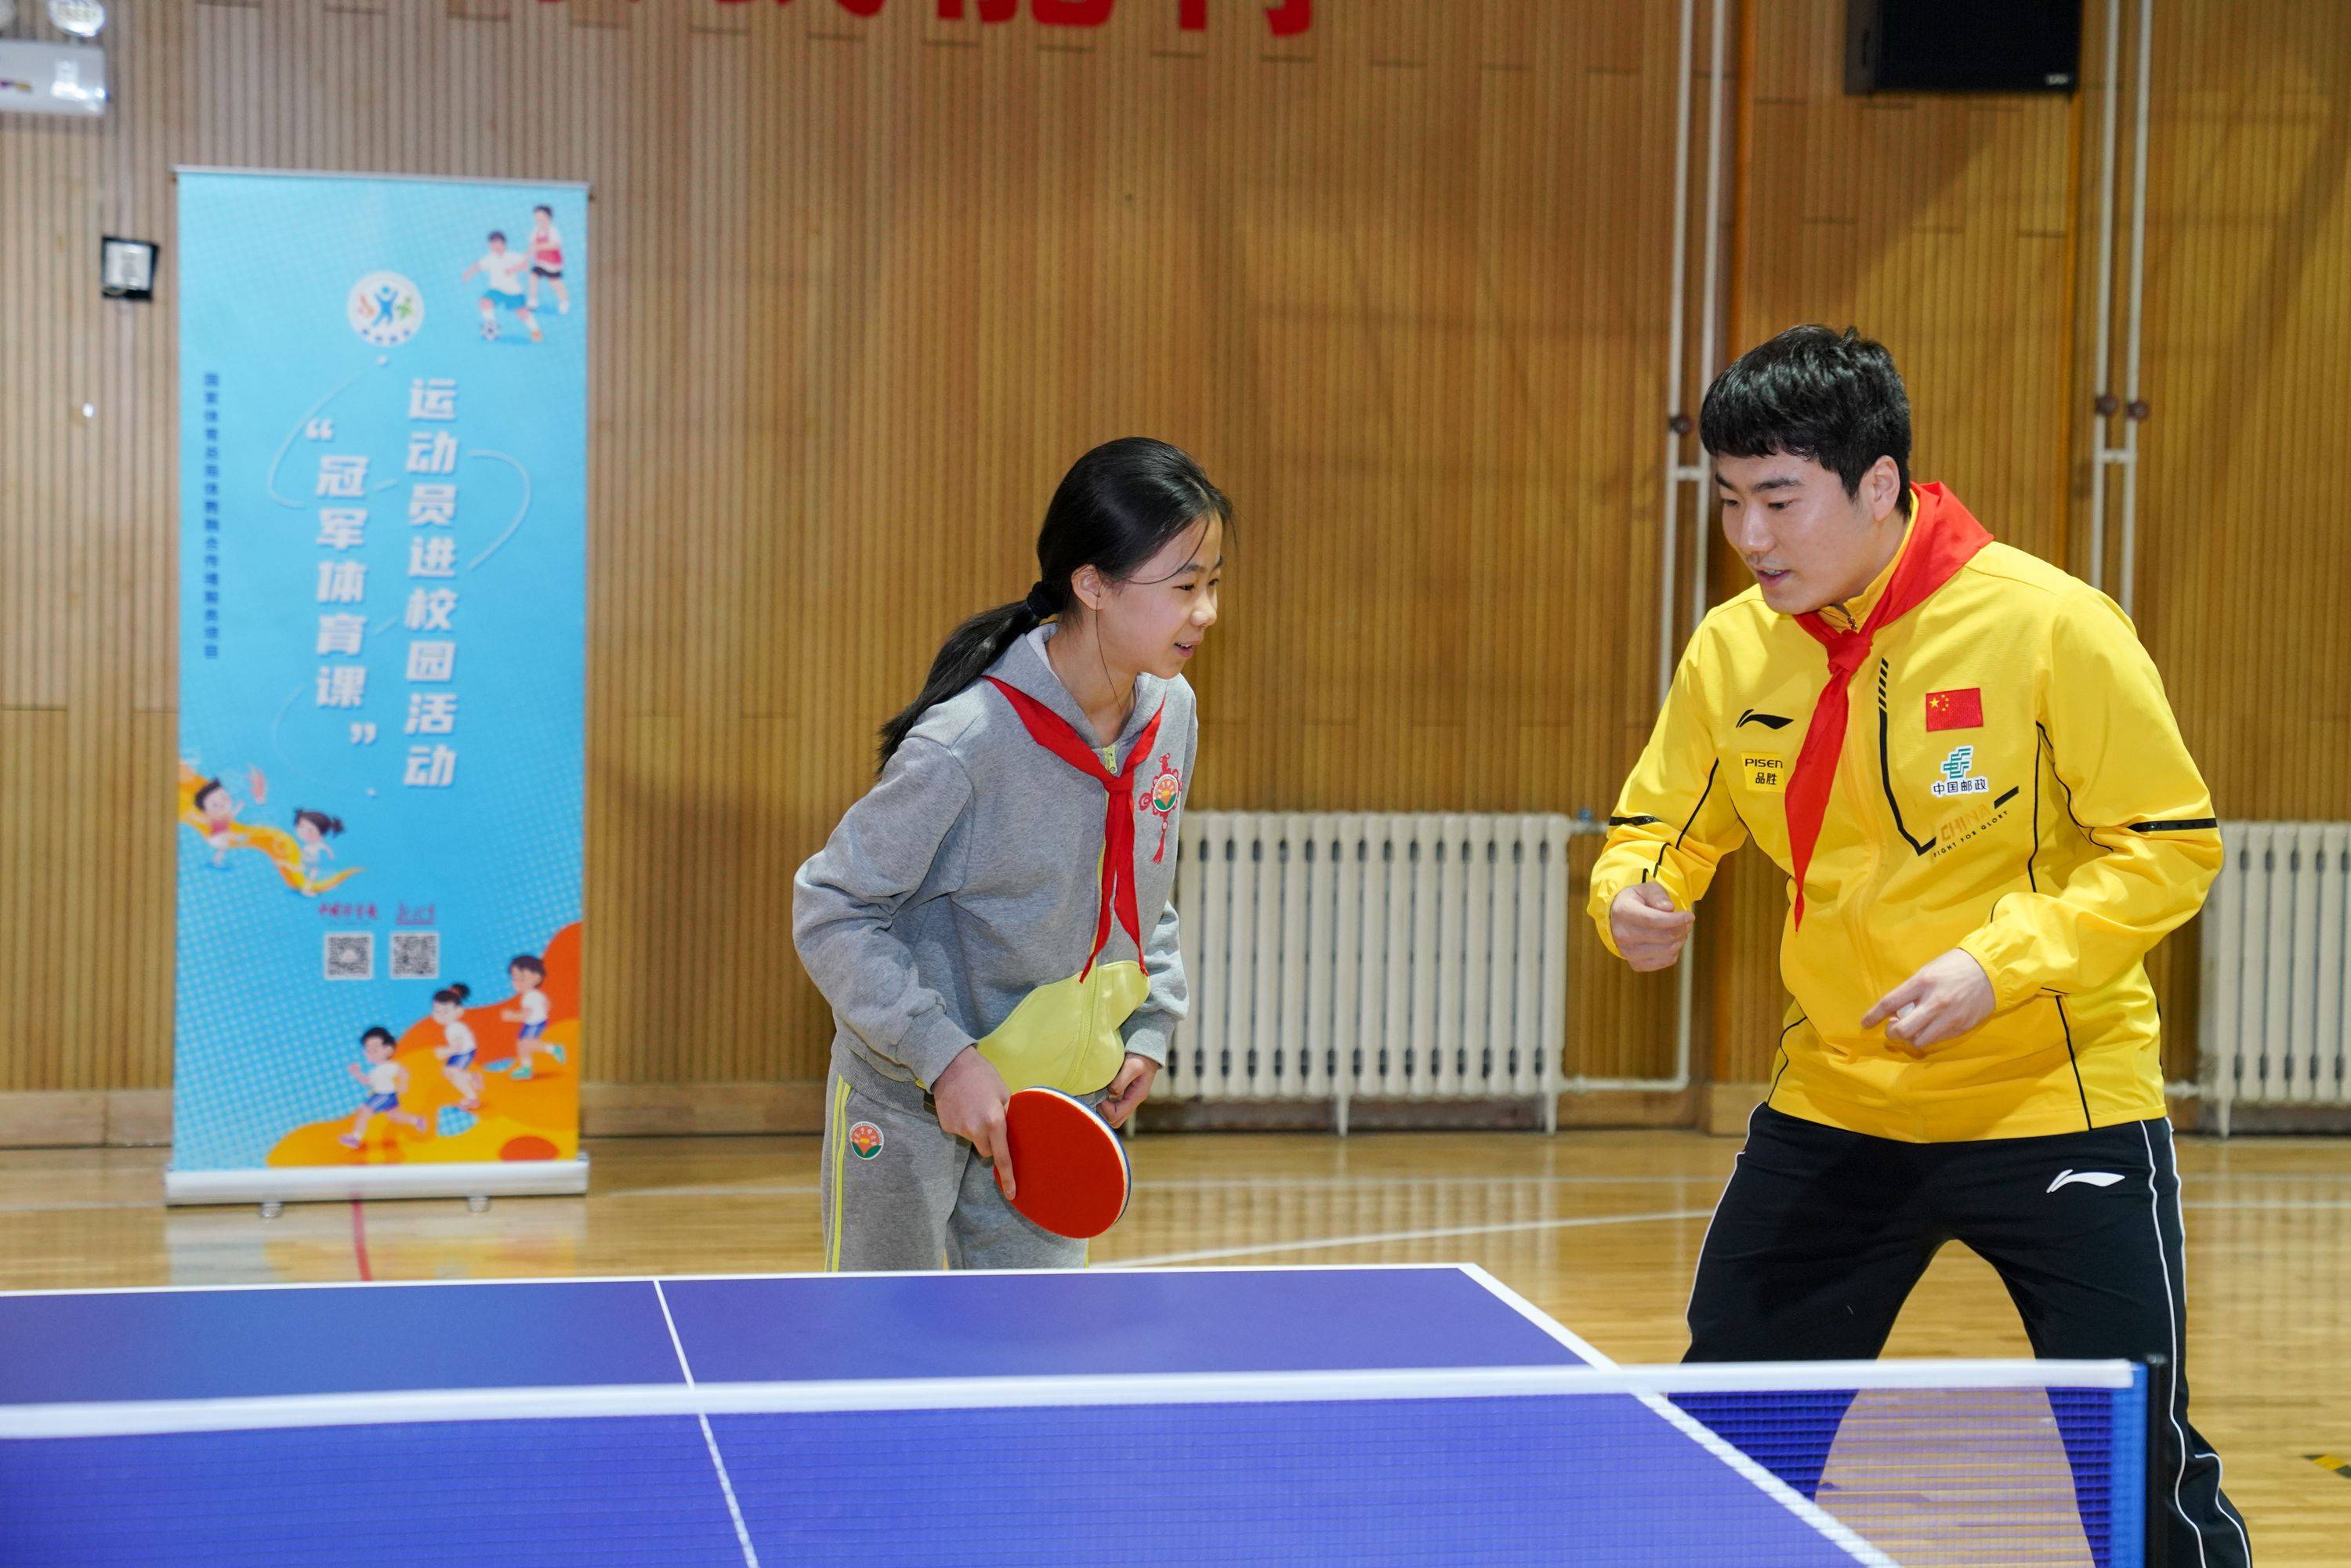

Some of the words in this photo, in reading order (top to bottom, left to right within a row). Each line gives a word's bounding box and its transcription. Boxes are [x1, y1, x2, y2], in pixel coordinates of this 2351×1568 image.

[403, 377, 460, 788] 运动员进校园活动
[1744, 758, 1783, 769] PISEN
[1755, 772, 1777, 785] 品胜
[1933, 778, 1987, 795] 中国邮政
[1933, 842, 1957, 857] FIGHT
[1960, 831, 1977, 842] FOR
[1980, 810, 2008, 831] GLORY
[1940, 803, 1991, 842] CHINA
